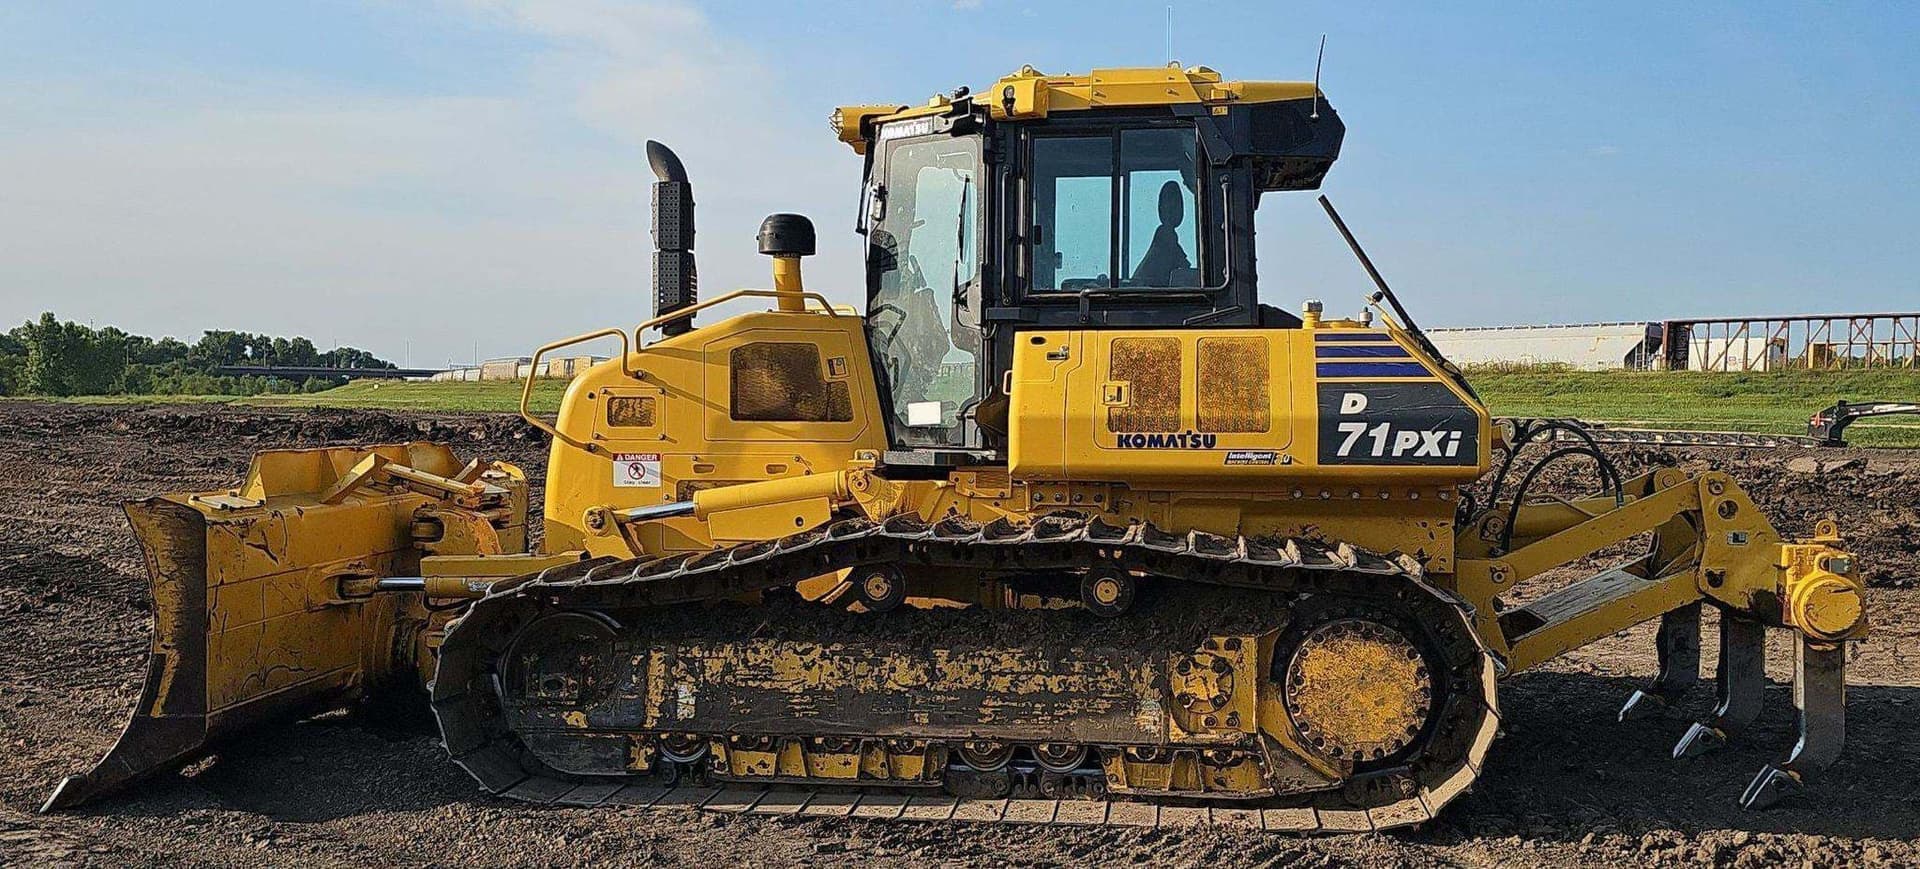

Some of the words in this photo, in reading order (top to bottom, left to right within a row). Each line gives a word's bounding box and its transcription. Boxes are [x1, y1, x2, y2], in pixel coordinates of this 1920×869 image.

[1340, 392, 1368, 415] D
[1117, 430, 1217, 449] KOMATSU
[1336, 422, 1462, 457] 71PXi
[1228, 452, 1272, 461] Intelligent
